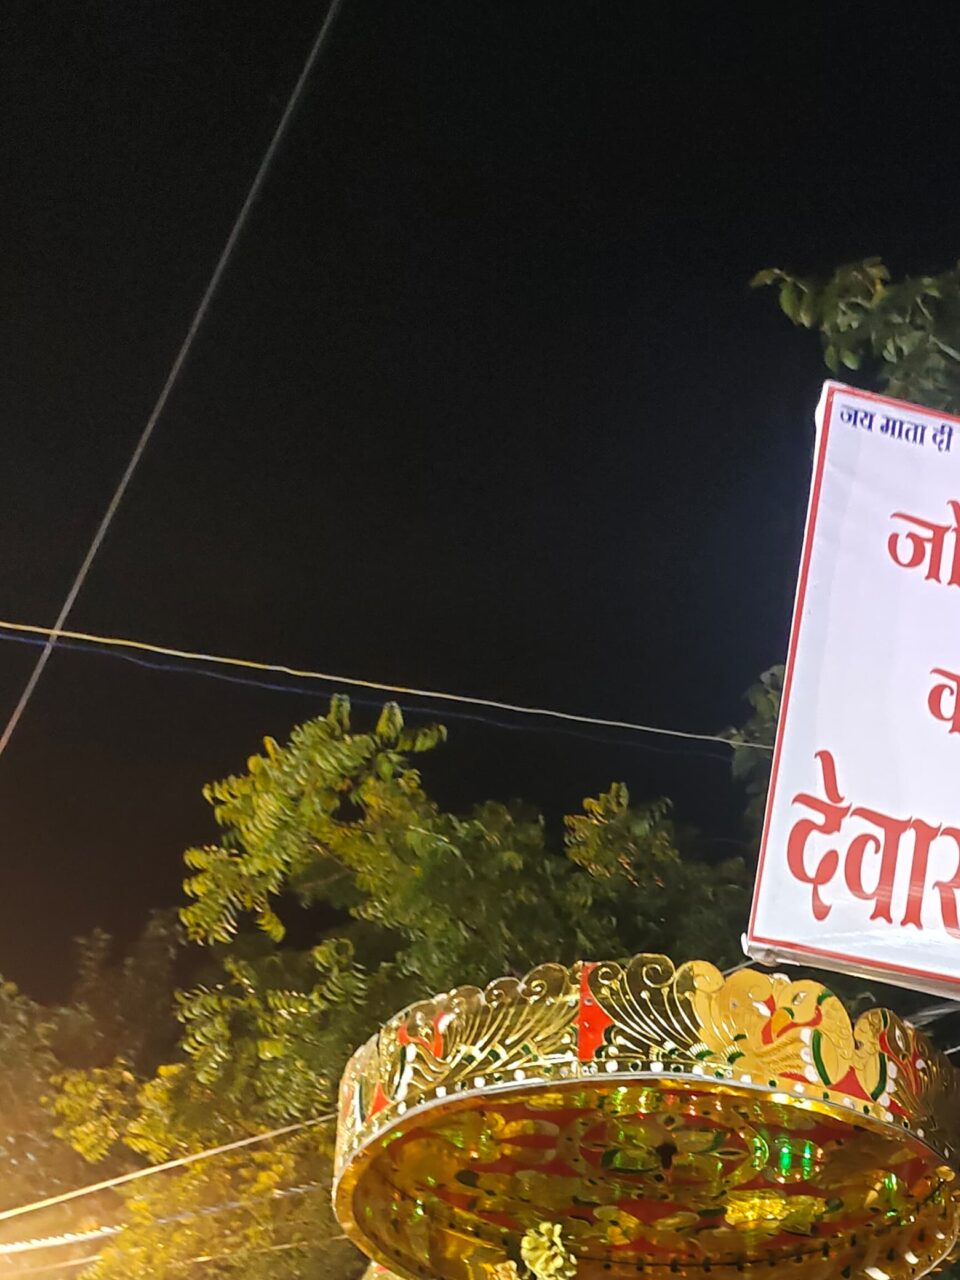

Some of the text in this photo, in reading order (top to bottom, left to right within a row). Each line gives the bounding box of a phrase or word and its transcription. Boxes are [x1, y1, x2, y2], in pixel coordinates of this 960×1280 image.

[840, 404, 954, 452] जय माता दी
